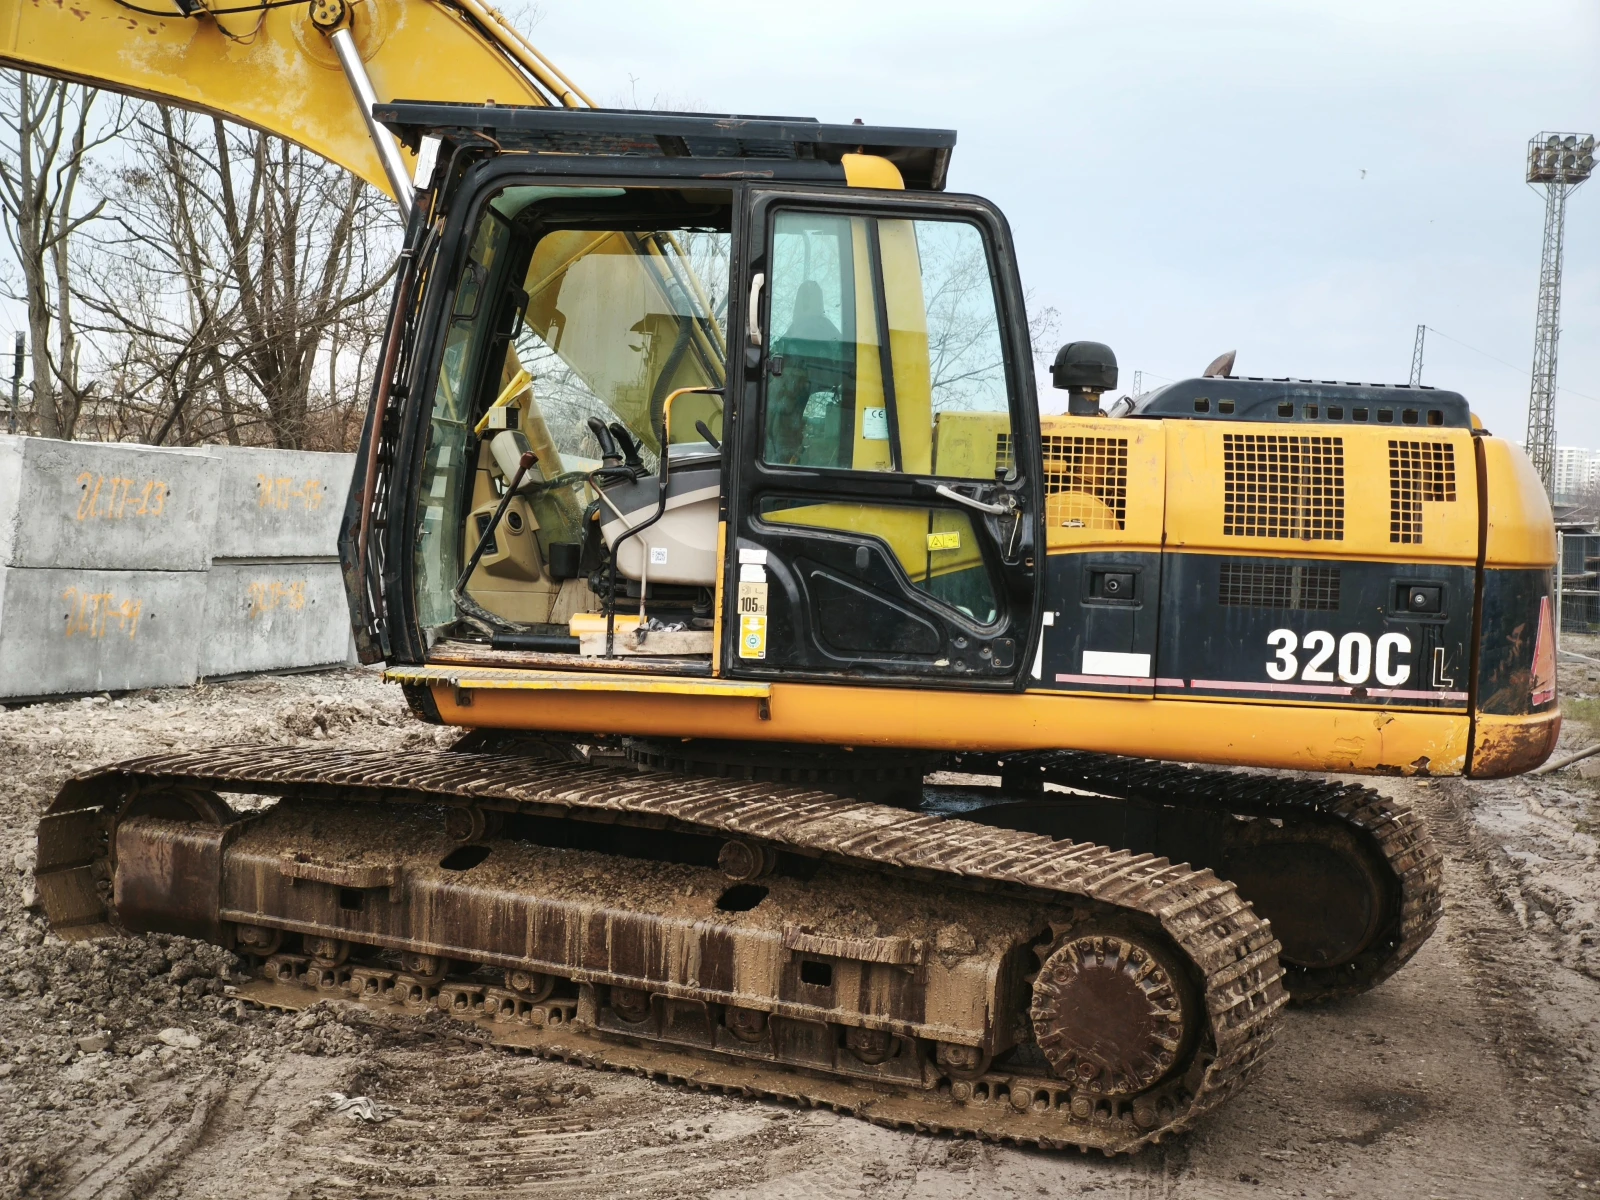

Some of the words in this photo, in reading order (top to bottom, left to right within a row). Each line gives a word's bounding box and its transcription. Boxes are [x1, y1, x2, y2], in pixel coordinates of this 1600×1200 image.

[741, 597, 758, 612] 105
[1266, 628, 1411, 686] 320C
[1432, 647, 1454, 688] L
